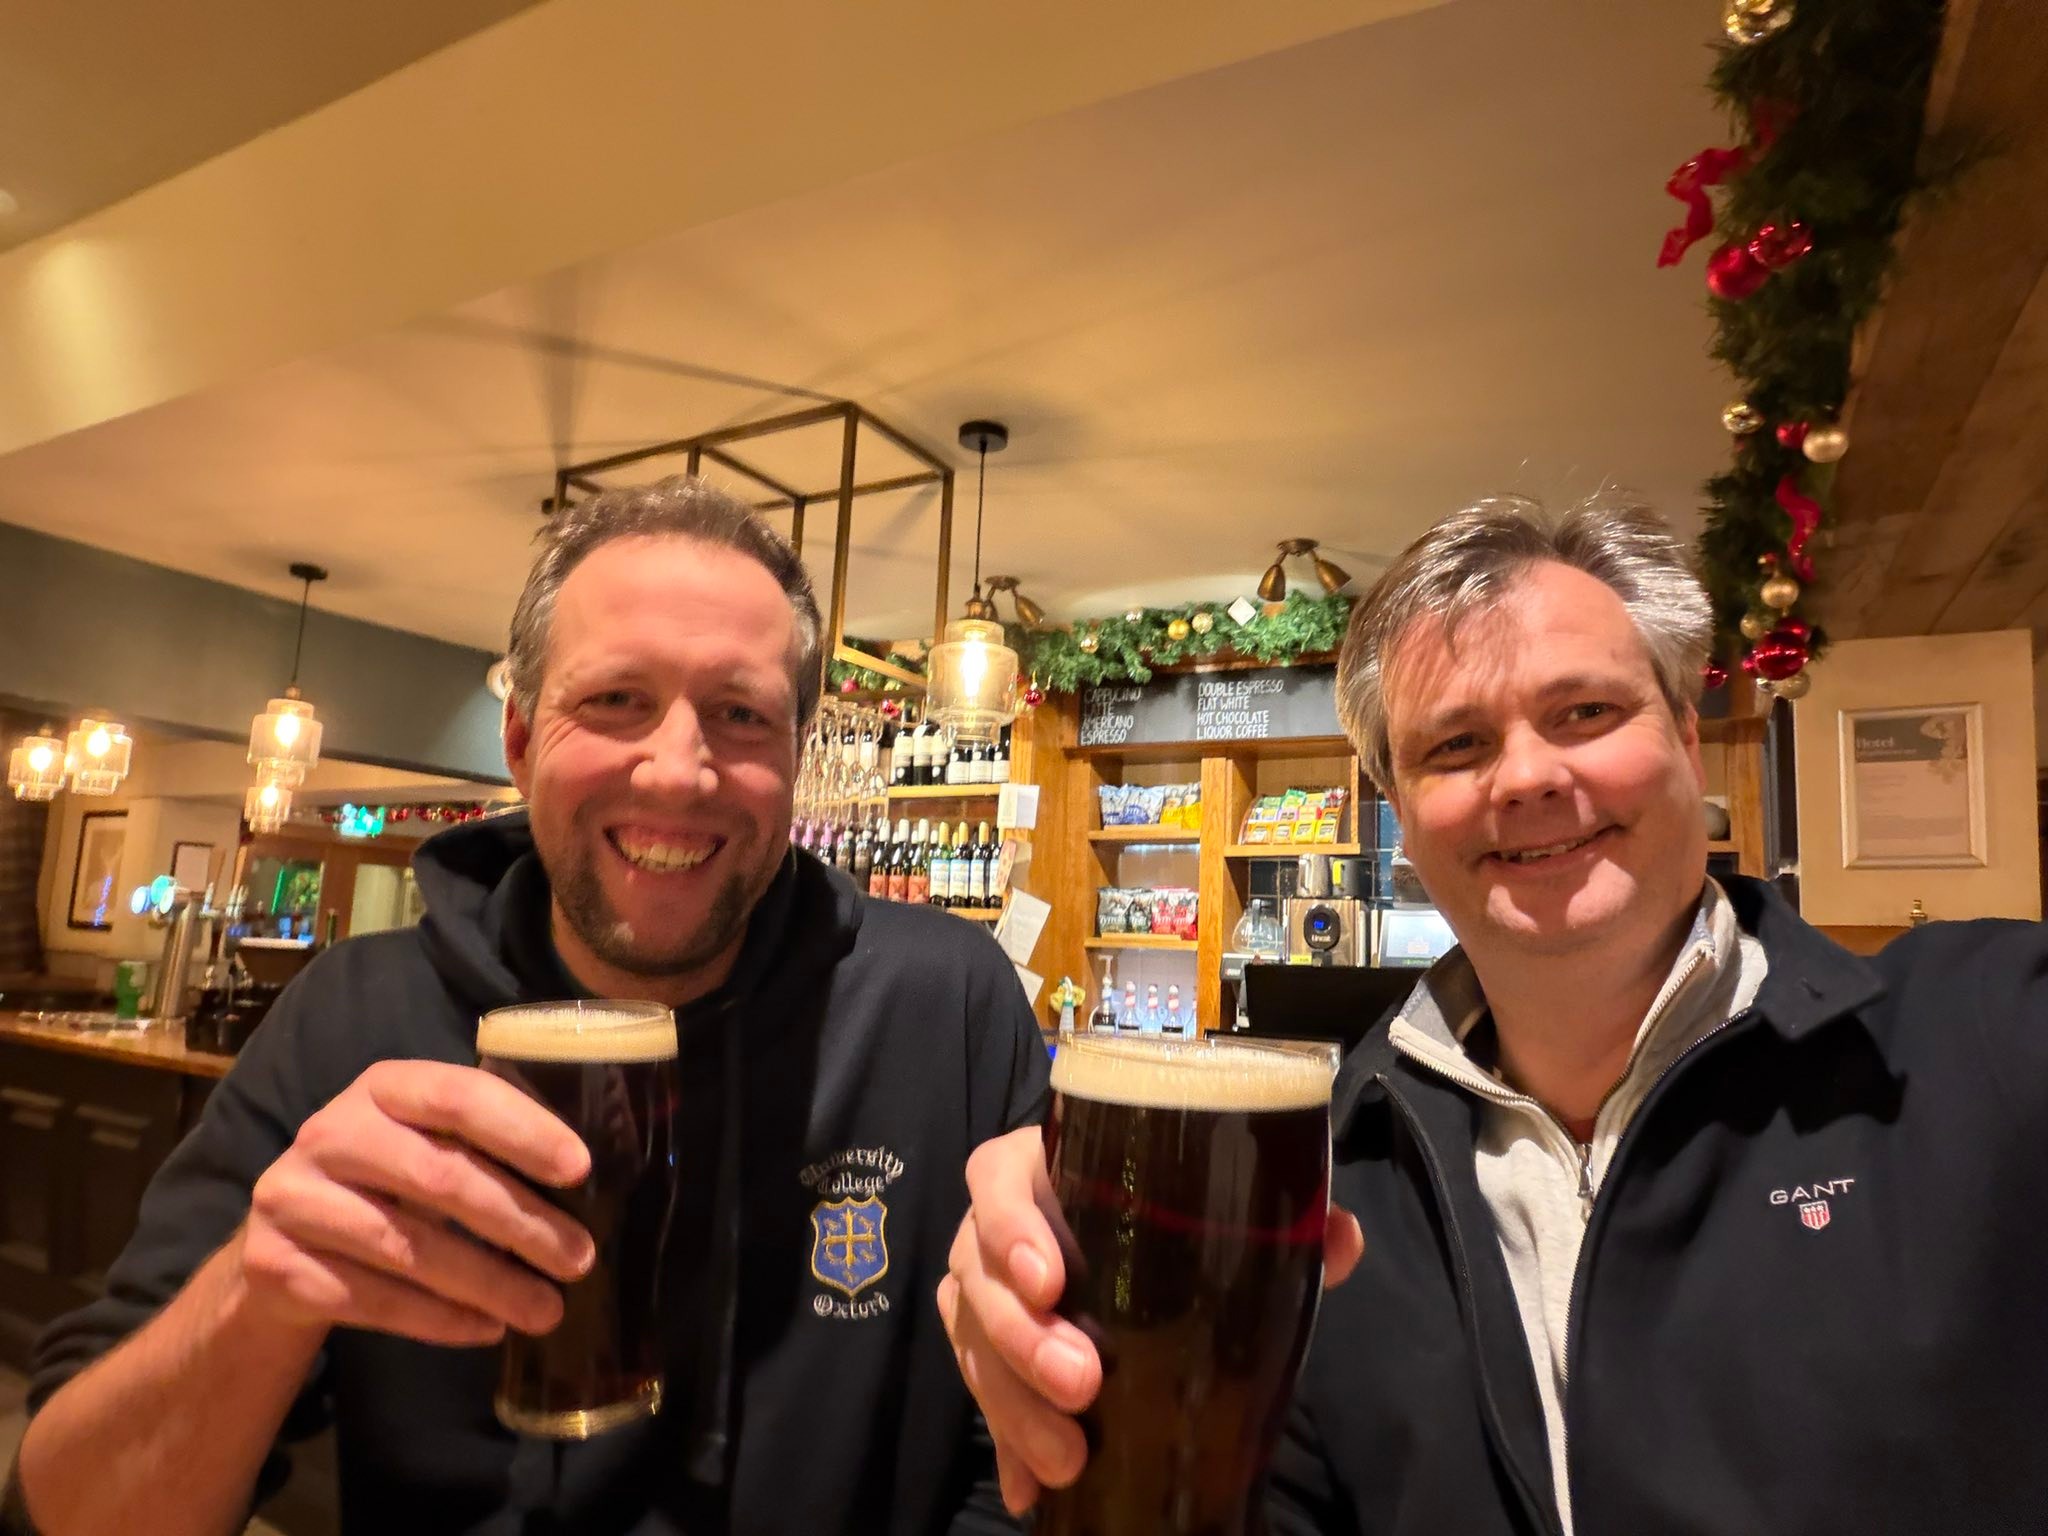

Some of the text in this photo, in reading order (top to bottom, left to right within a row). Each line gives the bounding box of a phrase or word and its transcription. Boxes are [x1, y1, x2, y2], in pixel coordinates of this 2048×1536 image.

[1198, 679, 1284, 697] DOUBLE ESPRESSO
[1197, 695, 1250, 711] FLAT WHITE
[1081, 715, 1134, 731] AMERICANO
[1196, 709, 1270, 726] HOT CHOCOLATE
[1080, 728, 1127, 746] ESPRESSO
[1196, 723, 1269, 740] LIQUOR COFFEE
[1769, 1178, 1855, 1205] GANT
[813, 1292, 890, 1319] Oxford
